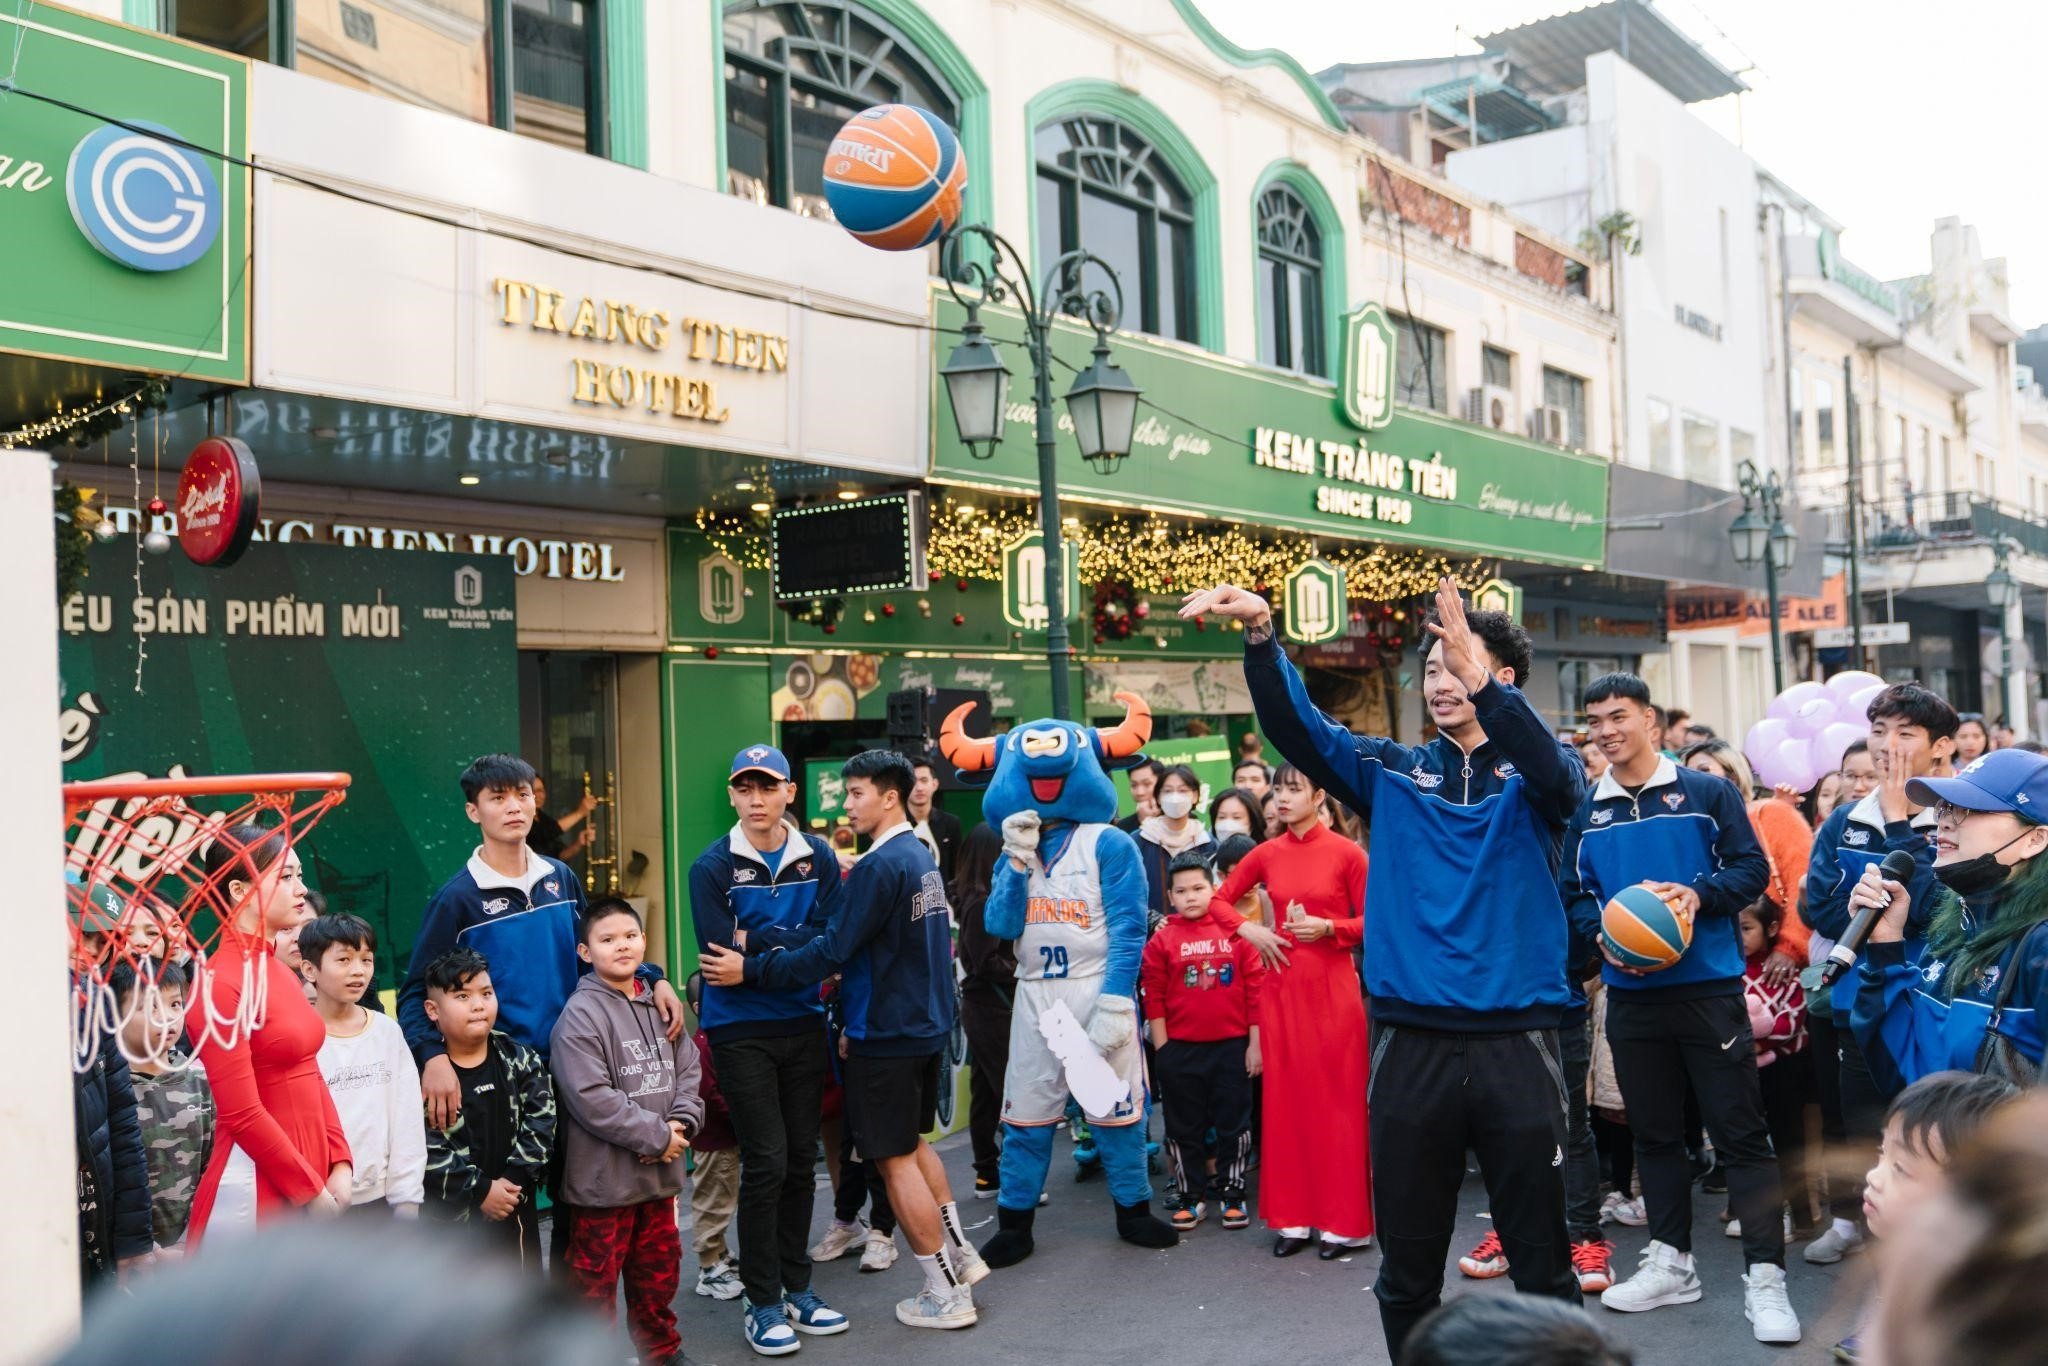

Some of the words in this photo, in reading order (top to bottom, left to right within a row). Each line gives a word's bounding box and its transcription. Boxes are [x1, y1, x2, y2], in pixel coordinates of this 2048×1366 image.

[492, 278, 671, 350] TRANG
[682, 317, 790, 372] TIEN
[571, 357, 730, 424] HOTEL
[1254, 426, 1315, 475] KEM
[1316, 485, 1373, 519] SINCE
[469, 534, 625, 582] HOTEL
[1745, 602, 1790, 620] ALE
[1796, 604, 1837, 621] ALE
[106, 893, 119, 915] LA
[1040, 946, 1069, 979] 29
[1181, 940, 1215, 957] AMONG
[1219, 939, 1232, 953] US
[620, 1063, 643, 1076] OUIS
